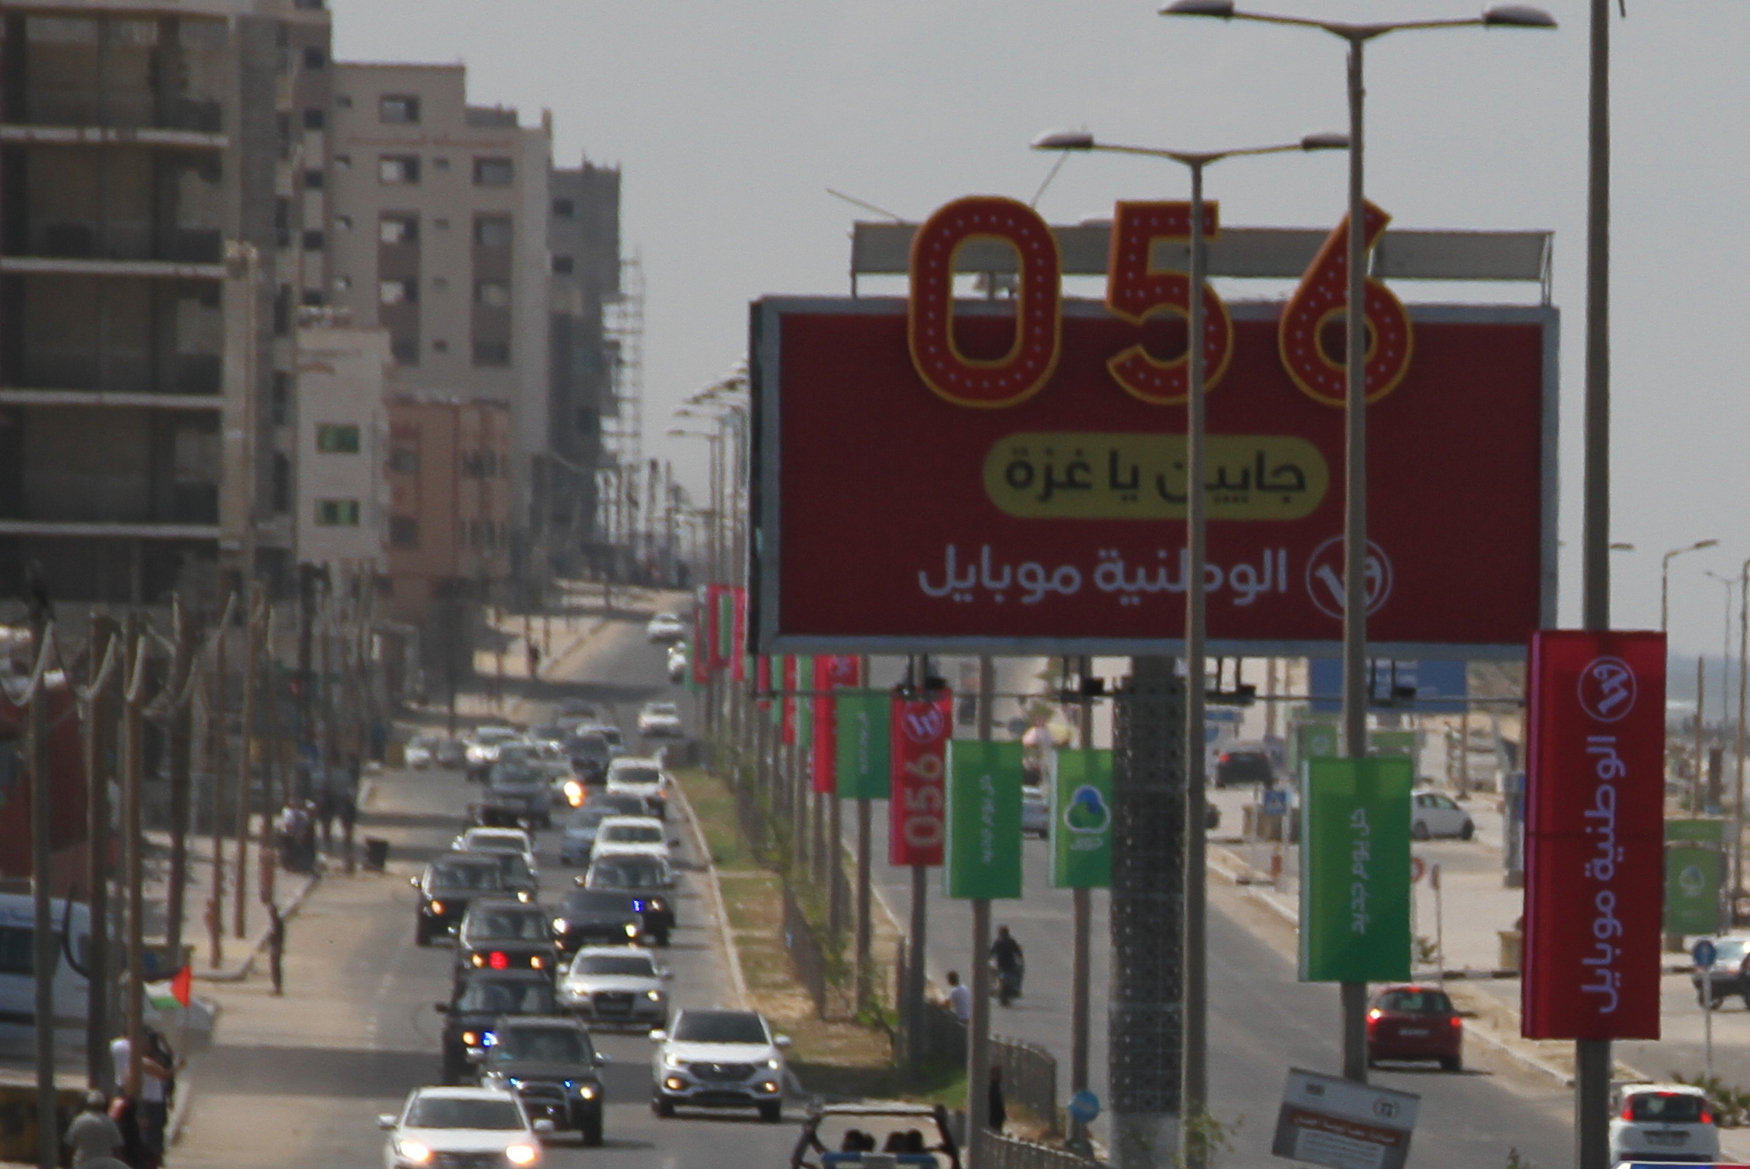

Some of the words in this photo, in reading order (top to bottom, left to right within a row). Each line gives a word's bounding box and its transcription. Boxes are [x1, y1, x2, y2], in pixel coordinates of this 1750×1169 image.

[907, 195, 1414, 408] 056
[1005, 446, 1093, 503] غزة
[1108, 449, 1140, 503] يا
[918, 543, 1083, 604] موبايل
[1094, 547, 1288, 607] الوطنية
[903, 753, 944, 848] 056
[1584, 735, 1626, 881] الوطنية
[1580, 890, 1623, 1014] موبايل
